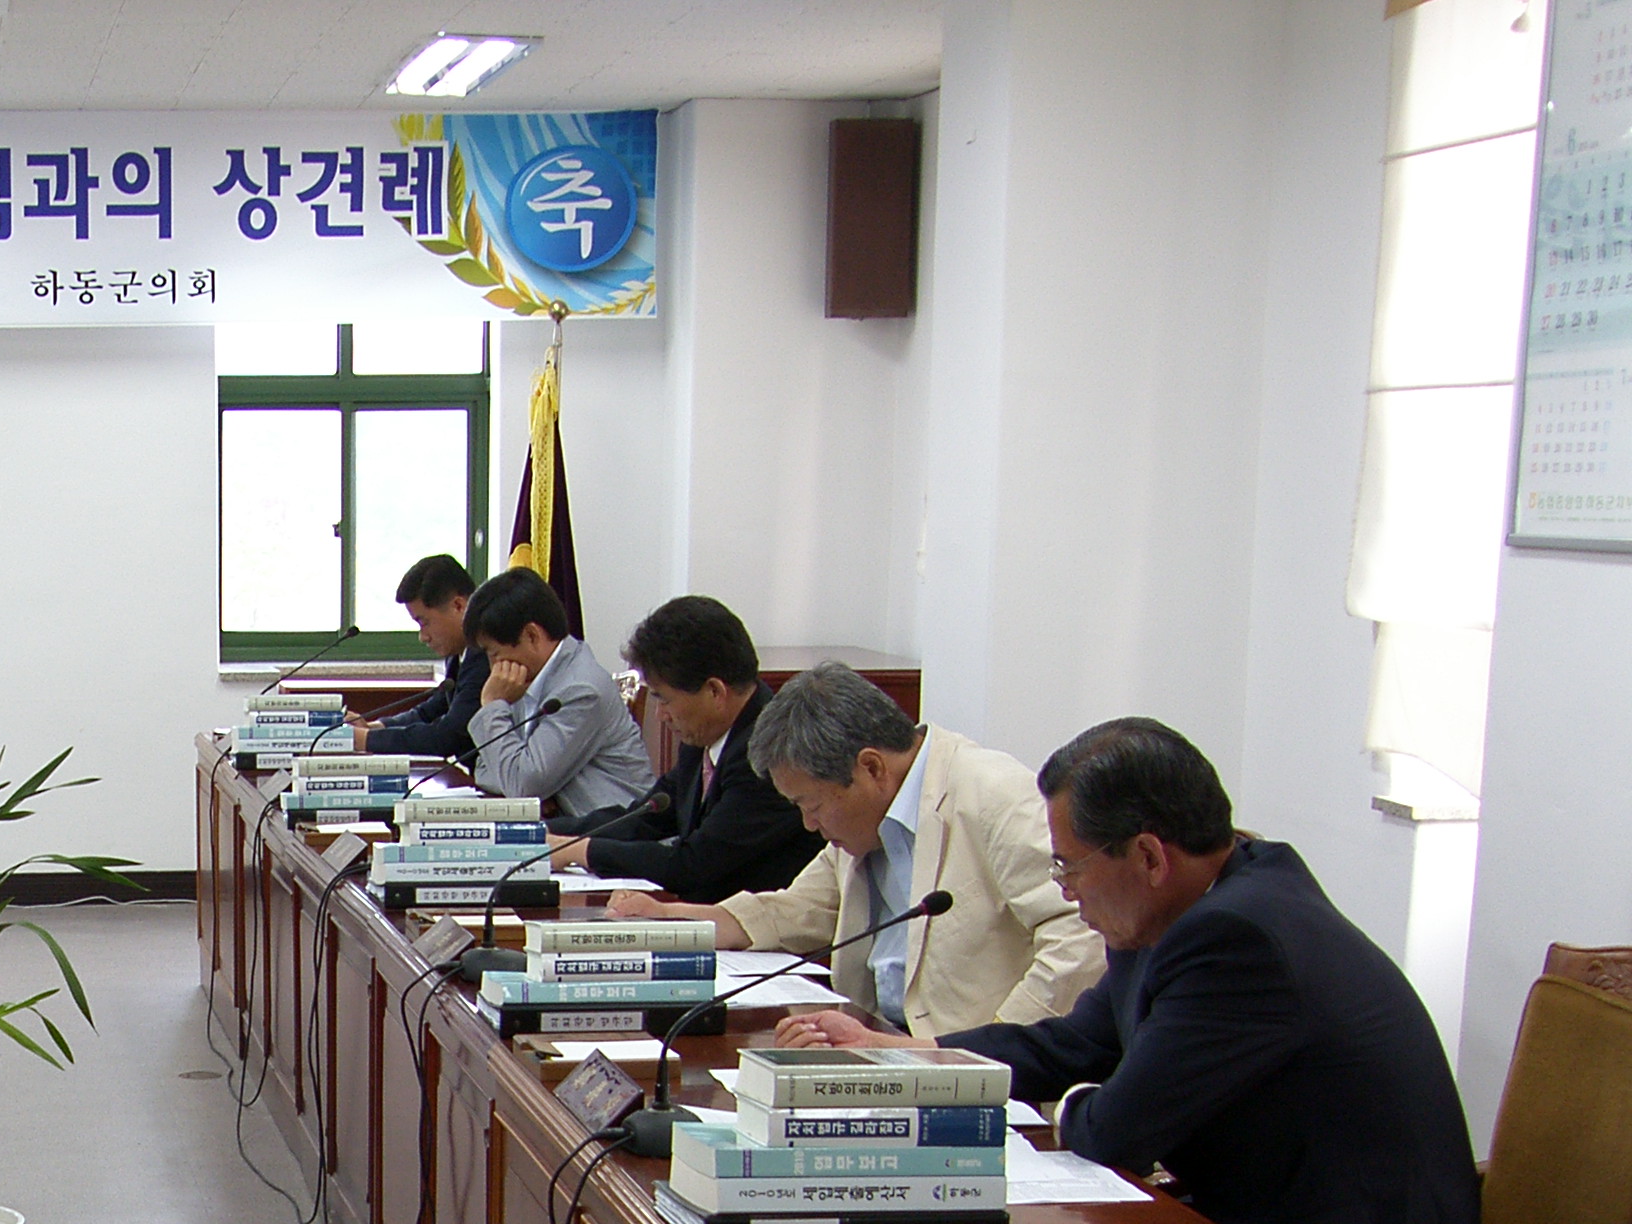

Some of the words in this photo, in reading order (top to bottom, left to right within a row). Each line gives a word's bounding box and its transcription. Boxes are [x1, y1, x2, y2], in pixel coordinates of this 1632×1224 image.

[213, 145, 444, 240] 상견례
[526, 158, 614, 258] 축
[31, 268, 219, 306] 하동군의회
[813, 1081, 904, 1097] 지방의회운영
[787, 1120, 846, 1136] 자치법규
[850, 1120, 909, 1135] 길라잡이
[813, 1154, 899, 1171] 업무보고
